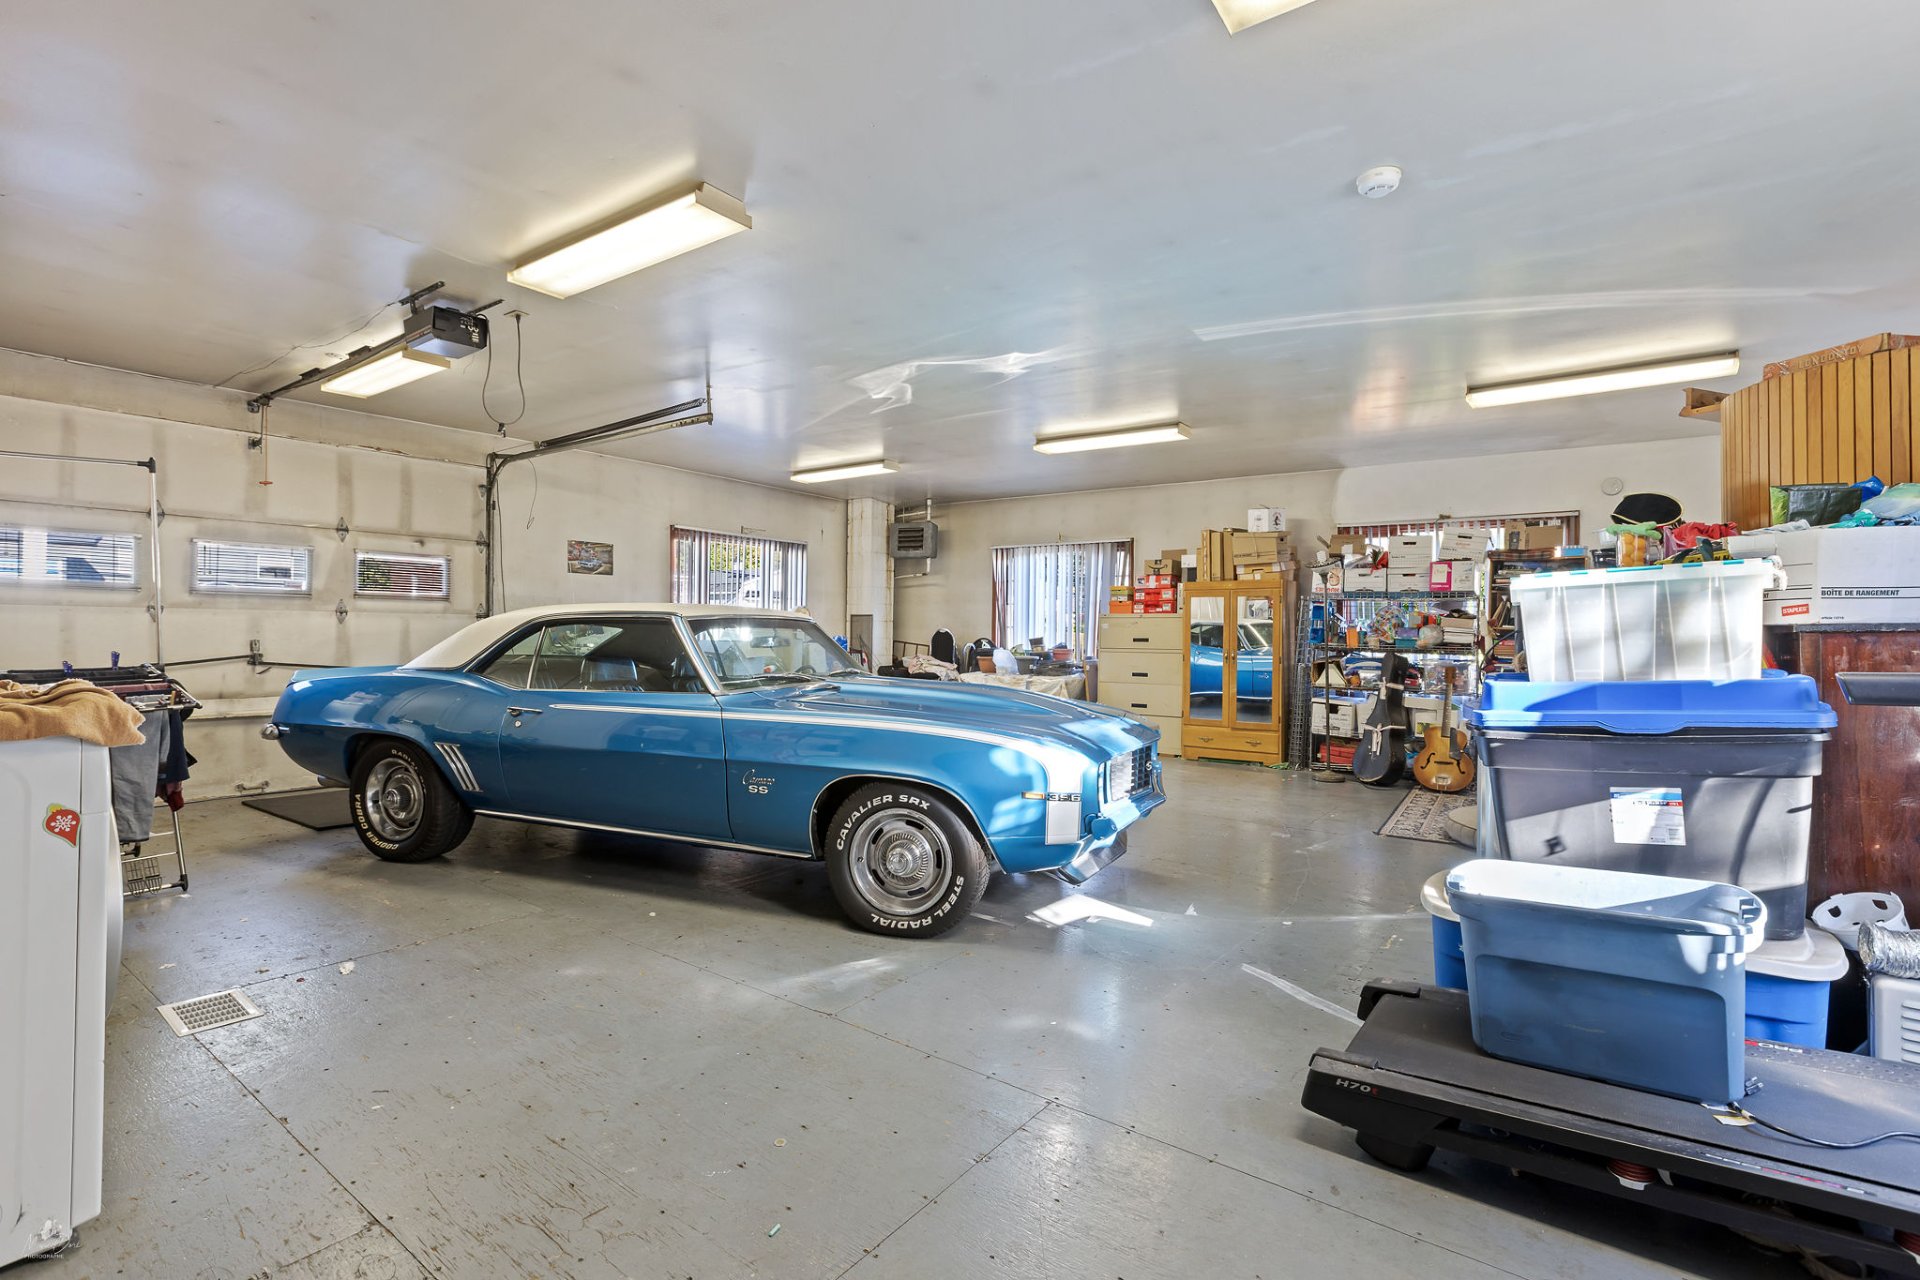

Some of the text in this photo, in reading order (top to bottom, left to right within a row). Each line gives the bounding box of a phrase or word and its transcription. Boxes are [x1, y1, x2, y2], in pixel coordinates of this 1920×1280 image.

[1821, 588, 1842, 597] BOÎTE
[1844, 589, 1854, 597] DE
[748, 785, 769, 794] SS
[1048, 792, 1080, 802] 396
[898, 794, 931, 810] SRX
[354, 793, 368, 830] COBRA
[836, 794, 893, 851] CAVALIER
[366, 830, 399, 851] COOPER
[933, 875, 965, 918] STEEL
[870, 913, 933, 930] RADIAL
